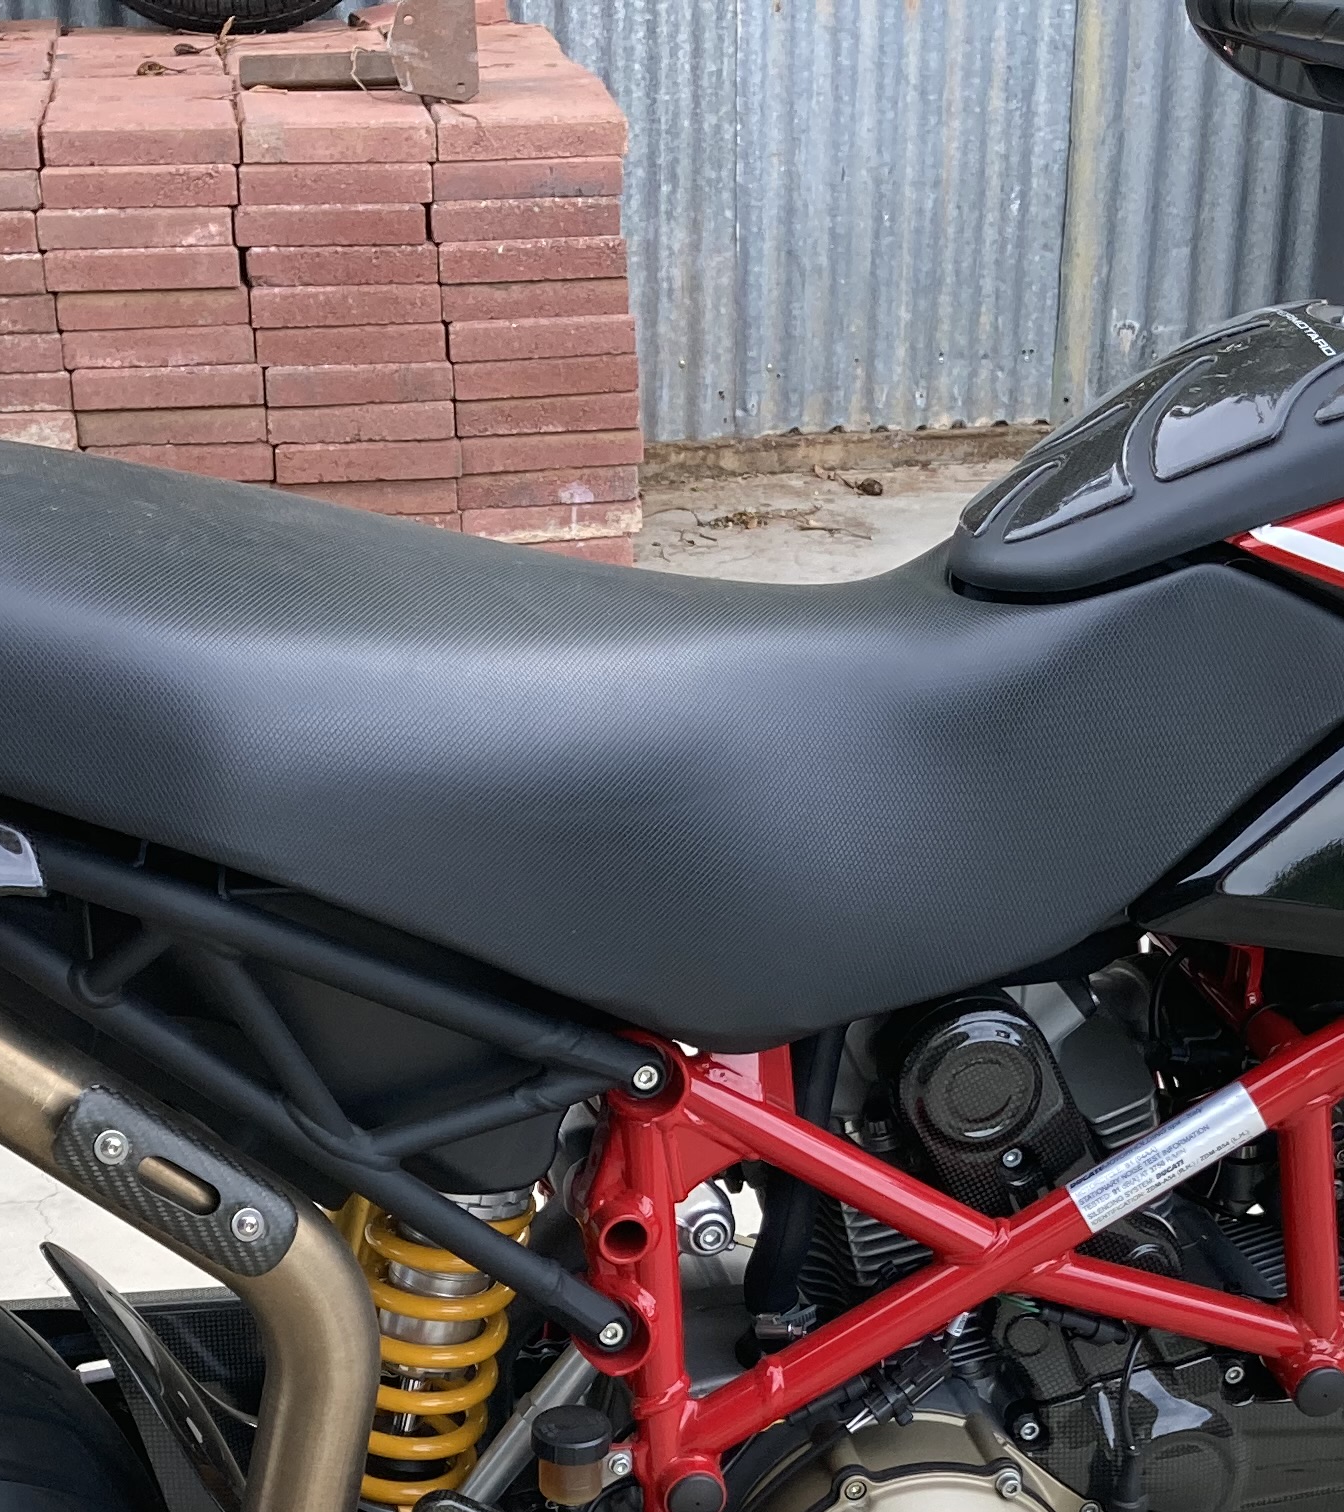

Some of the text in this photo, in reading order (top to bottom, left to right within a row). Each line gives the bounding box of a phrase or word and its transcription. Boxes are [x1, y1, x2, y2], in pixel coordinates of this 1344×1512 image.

[1078, 1176, 1120, 1205] STATIONARY
[1120, 1163, 1143, 1180] NOISE
[1142, 1152, 1161, 1167] TEST
[1160, 1123, 1209, 1156] INFORMATION
[1086, 1194, 1124, 1220] SILENCING
[1154, 1158, 1184, 1179] DUCATI
